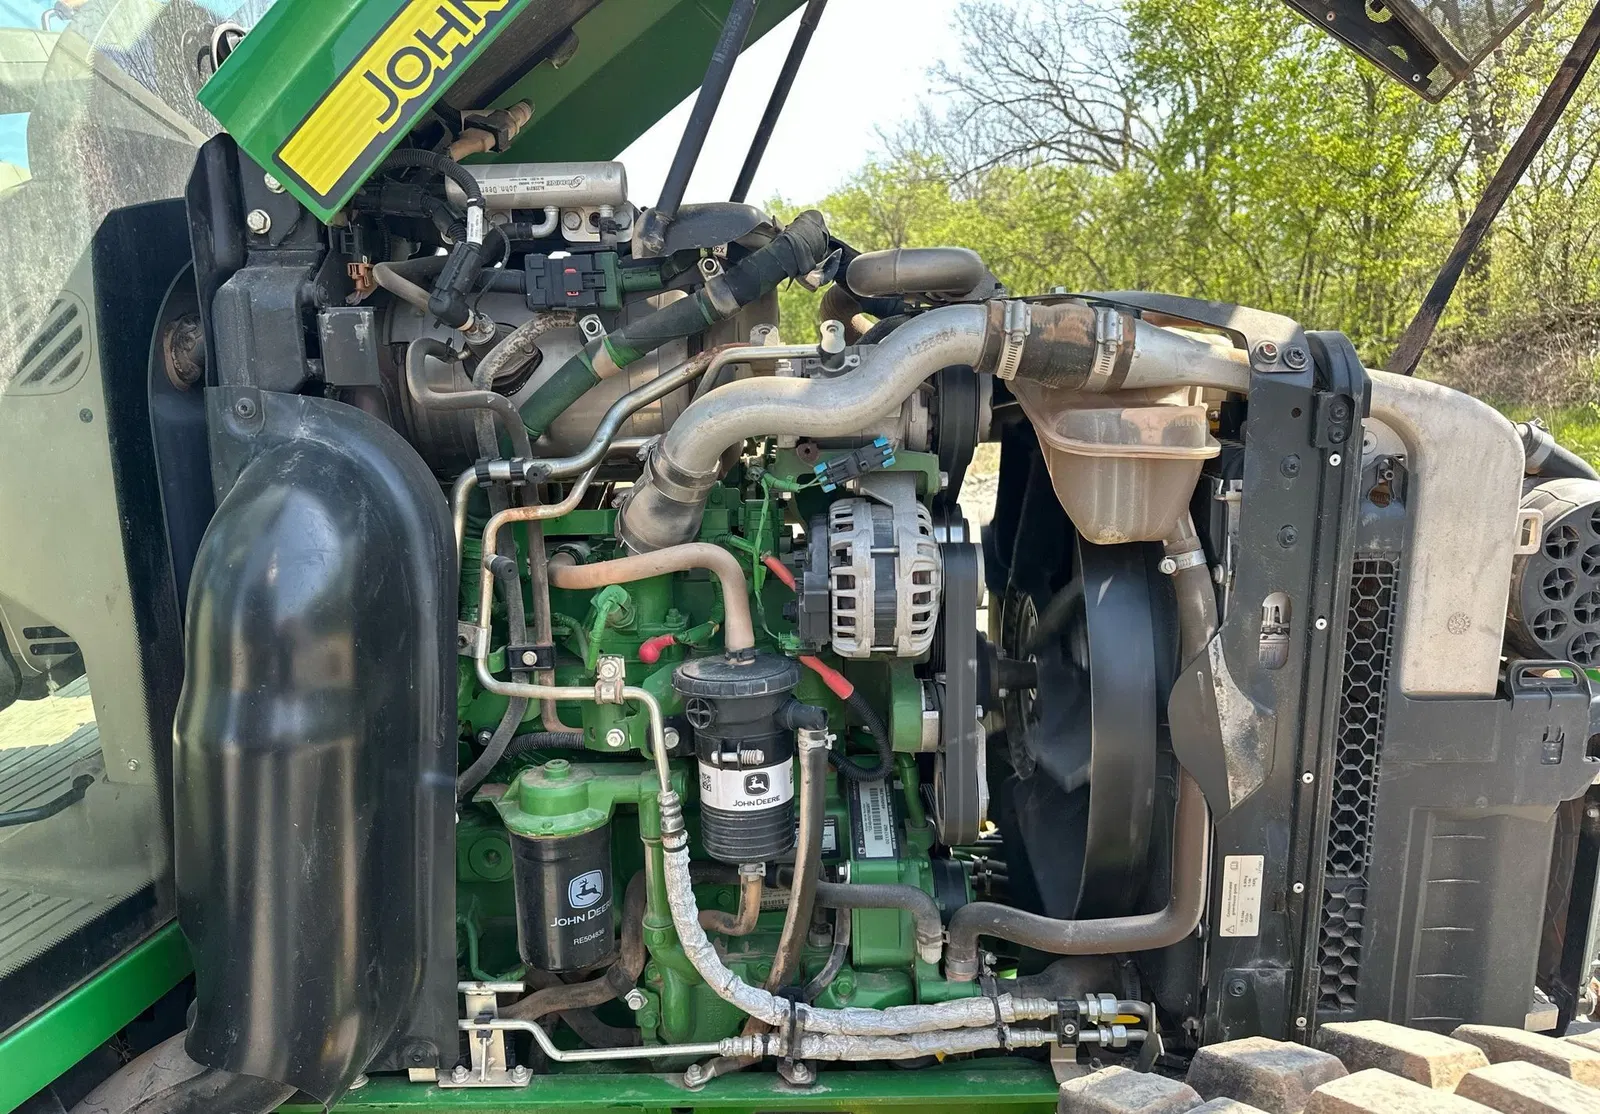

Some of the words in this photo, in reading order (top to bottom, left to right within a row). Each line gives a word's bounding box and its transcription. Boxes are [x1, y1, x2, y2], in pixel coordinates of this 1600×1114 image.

[481, 186, 498, 194] Deer
[500, 184, 518, 192] John
[733, 799, 756, 807] JOHN
[756, 795, 781, 806] DEERE
[550, 914, 586, 927] JOHN
[587, 897, 612, 920] DEER
